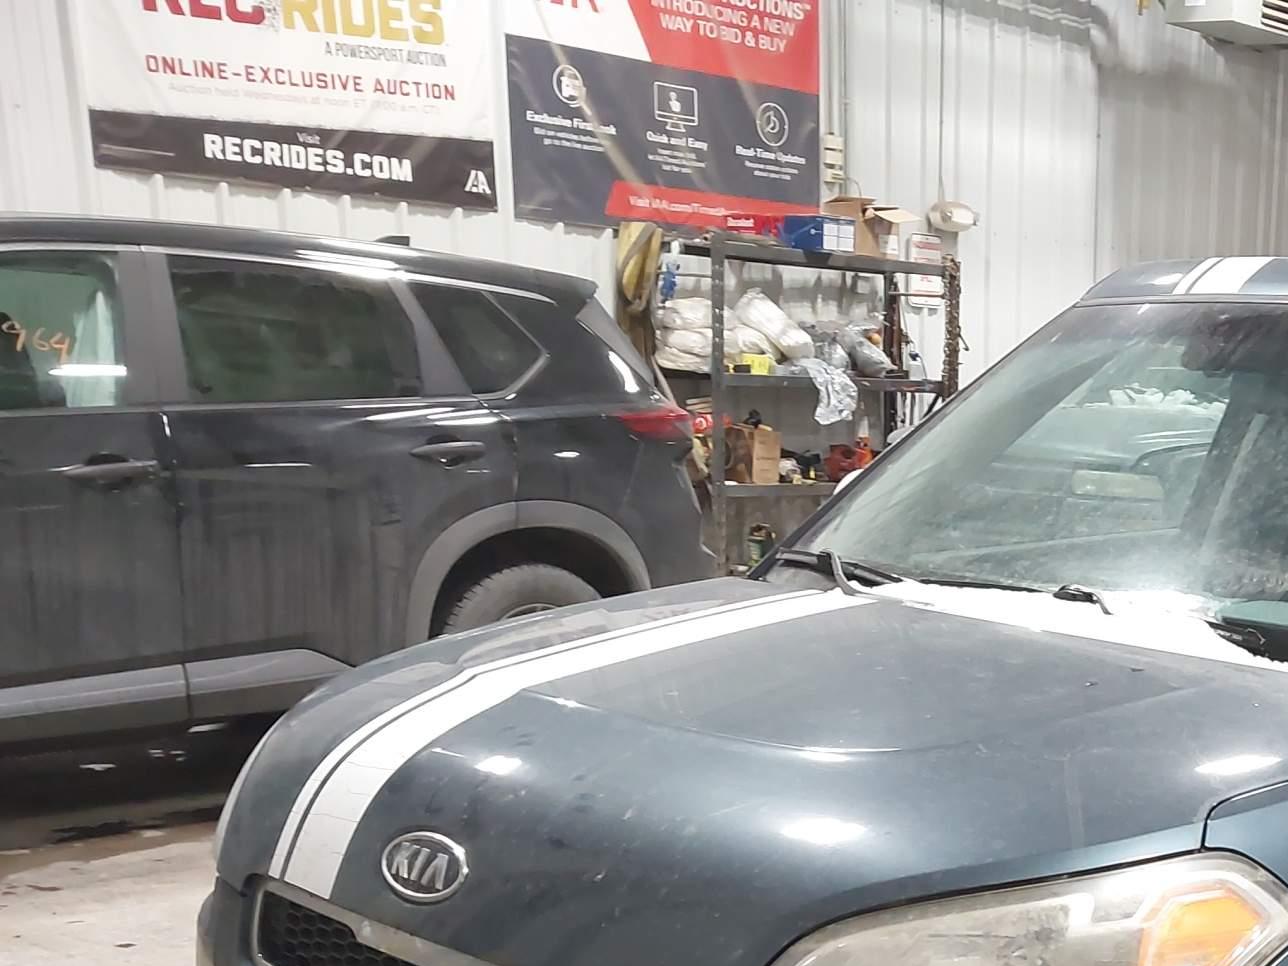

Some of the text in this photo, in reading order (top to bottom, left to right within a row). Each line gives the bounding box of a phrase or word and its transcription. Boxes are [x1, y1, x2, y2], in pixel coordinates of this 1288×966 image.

[659, 12, 787, 52] WAY TO BID & BUY
[750, 14, 761, 30] A
[764, 17, 796, 36] NEW
[145, 54, 365, 93] ONLINE-EXCLUSIVE
[373, 77, 456, 101] AUCTION
[407, 50, 447, 67] AUCTION
[203, 133, 414, 182] RECRIDES.COM
[296, 131, 321, 145] Visit
[391, 841, 448, 890] KIA
